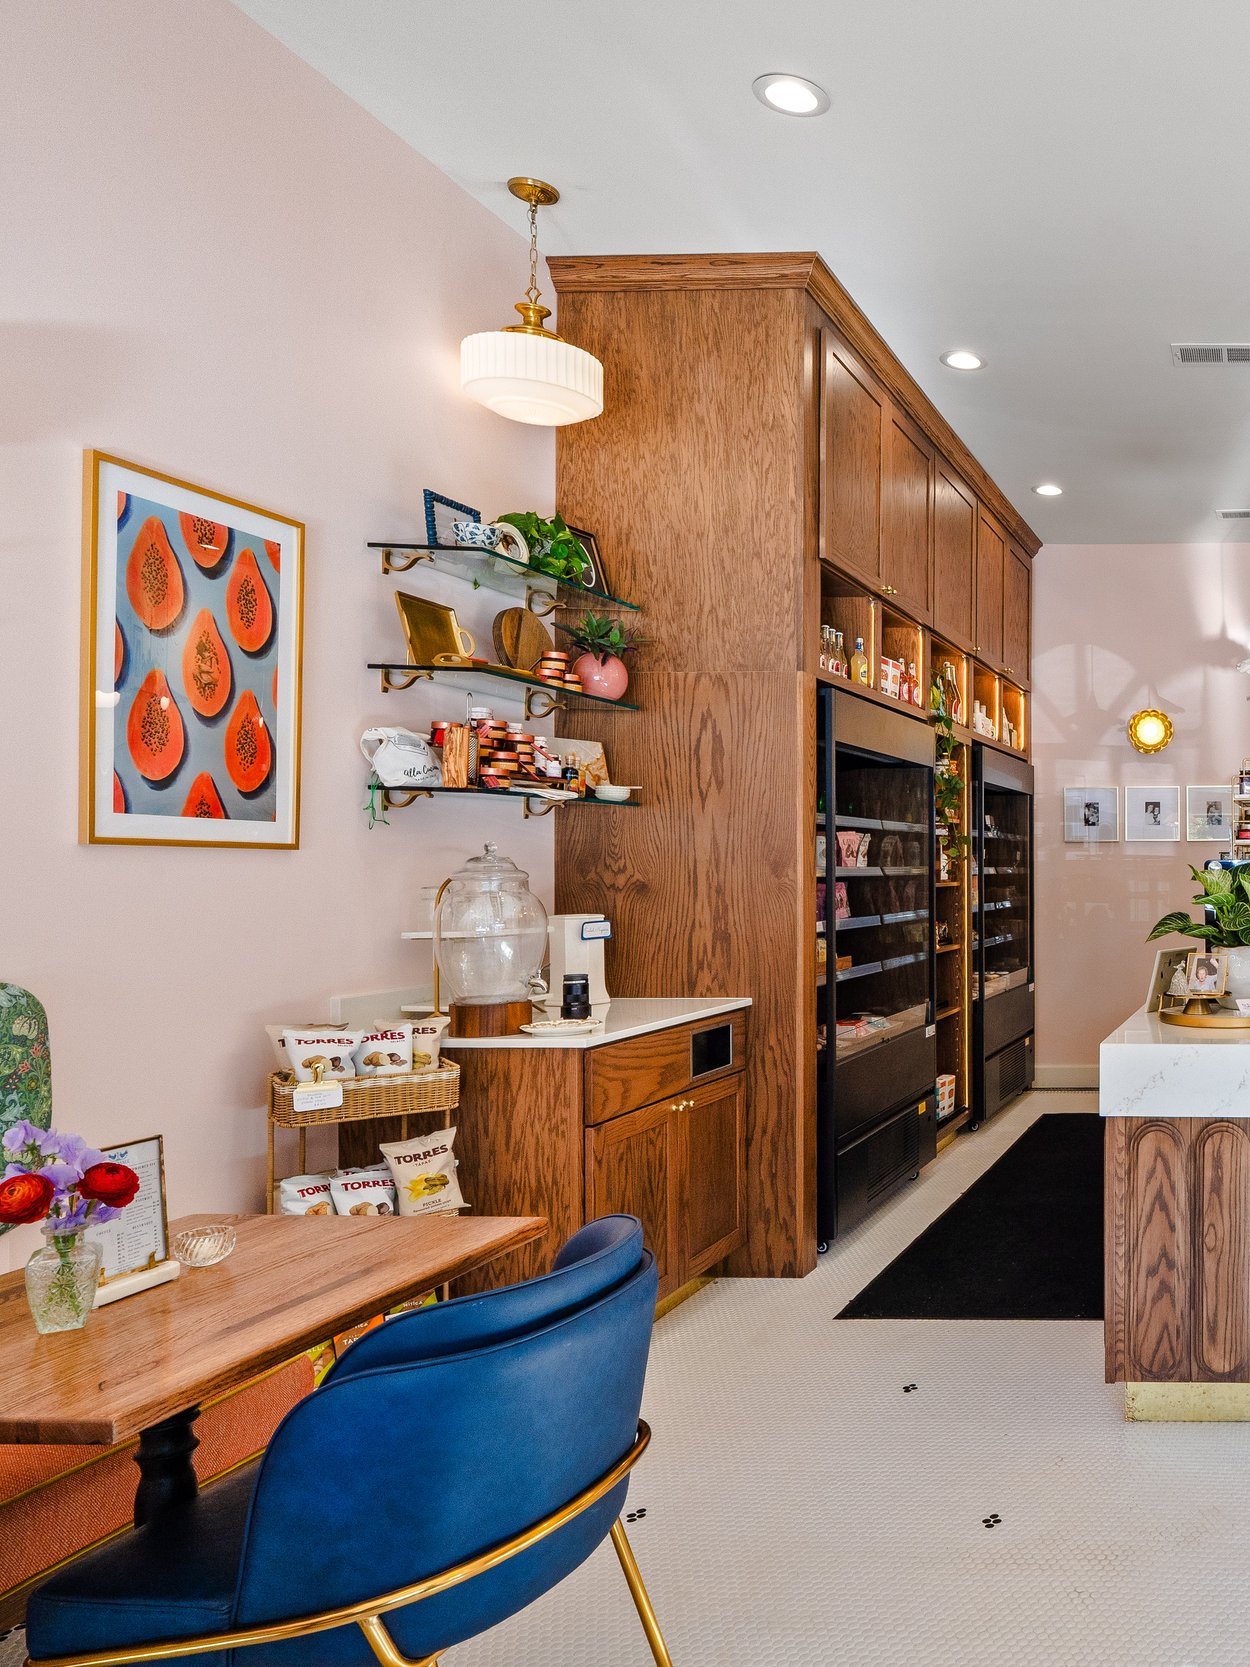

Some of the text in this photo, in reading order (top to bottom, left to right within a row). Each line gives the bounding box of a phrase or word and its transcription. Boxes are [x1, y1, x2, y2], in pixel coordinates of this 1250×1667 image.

[412, 1027, 437, 1035] RES
[394, 1144, 449, 1165] TORRES
[297, 1183, 330, 1198] TORR
[341, 1178, 395, 1192] TORRES
